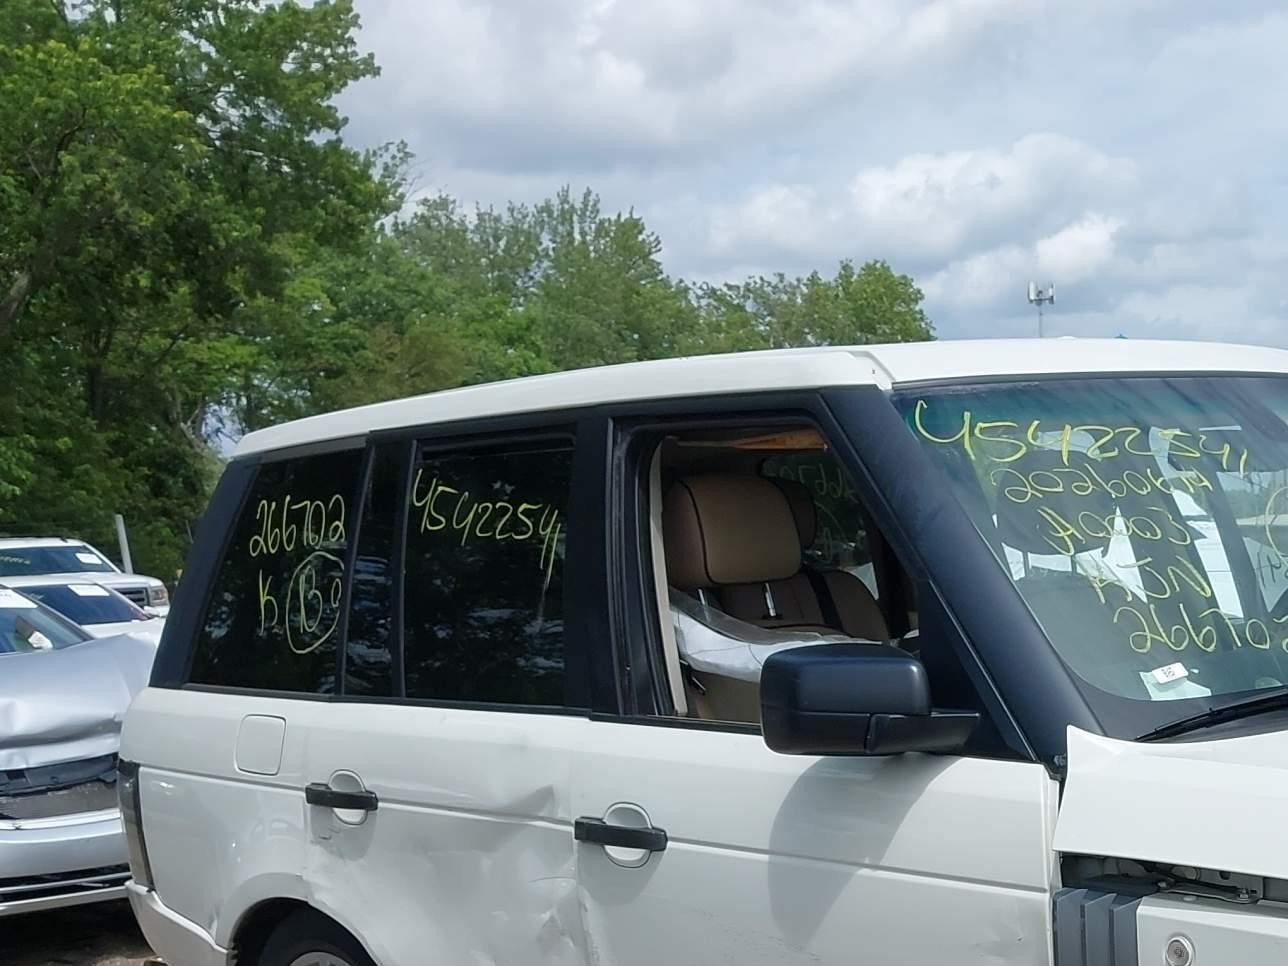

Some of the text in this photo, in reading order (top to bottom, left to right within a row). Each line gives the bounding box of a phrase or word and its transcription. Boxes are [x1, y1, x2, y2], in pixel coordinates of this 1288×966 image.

[914, 399, 1249, 480] 45422541
[250, 494, 346, 558] 266702
[412, 468, 562, 586] 45422541
